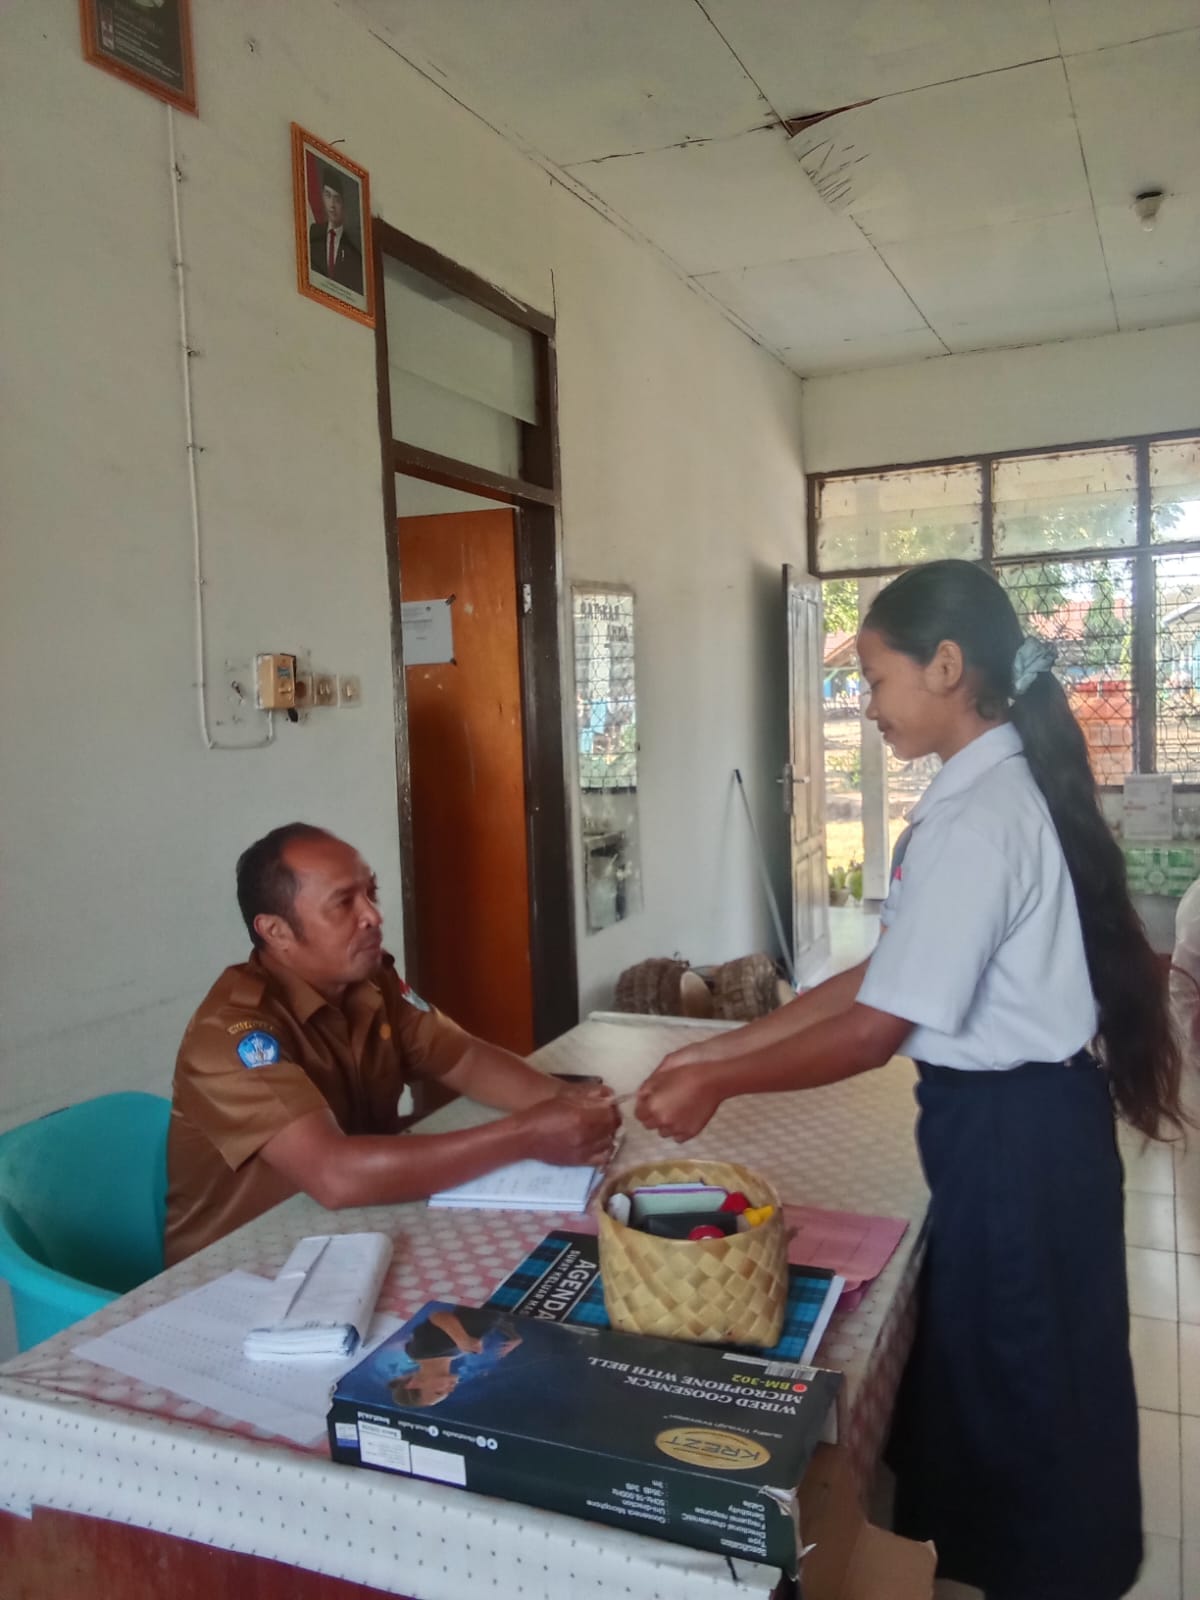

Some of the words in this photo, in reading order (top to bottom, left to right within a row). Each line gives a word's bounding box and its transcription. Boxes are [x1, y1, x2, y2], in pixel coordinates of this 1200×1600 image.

[532, 1271, 562, 1299] KELUAR
[534, 1259, 597, 1320] AGENDA
[588, 1356, 629, 1372] BELL
[633, 1366, 677, 1382] WITH
[624, 1375, 733, 1404] GOOSENECK
[682, 1375, 803, 1404] MICROPHONE
[731, 1374, 790, 1390] BM-302
[736, 1398, 797, 1415] WIRED
[664, 1436, 760, 1460] KREZT
